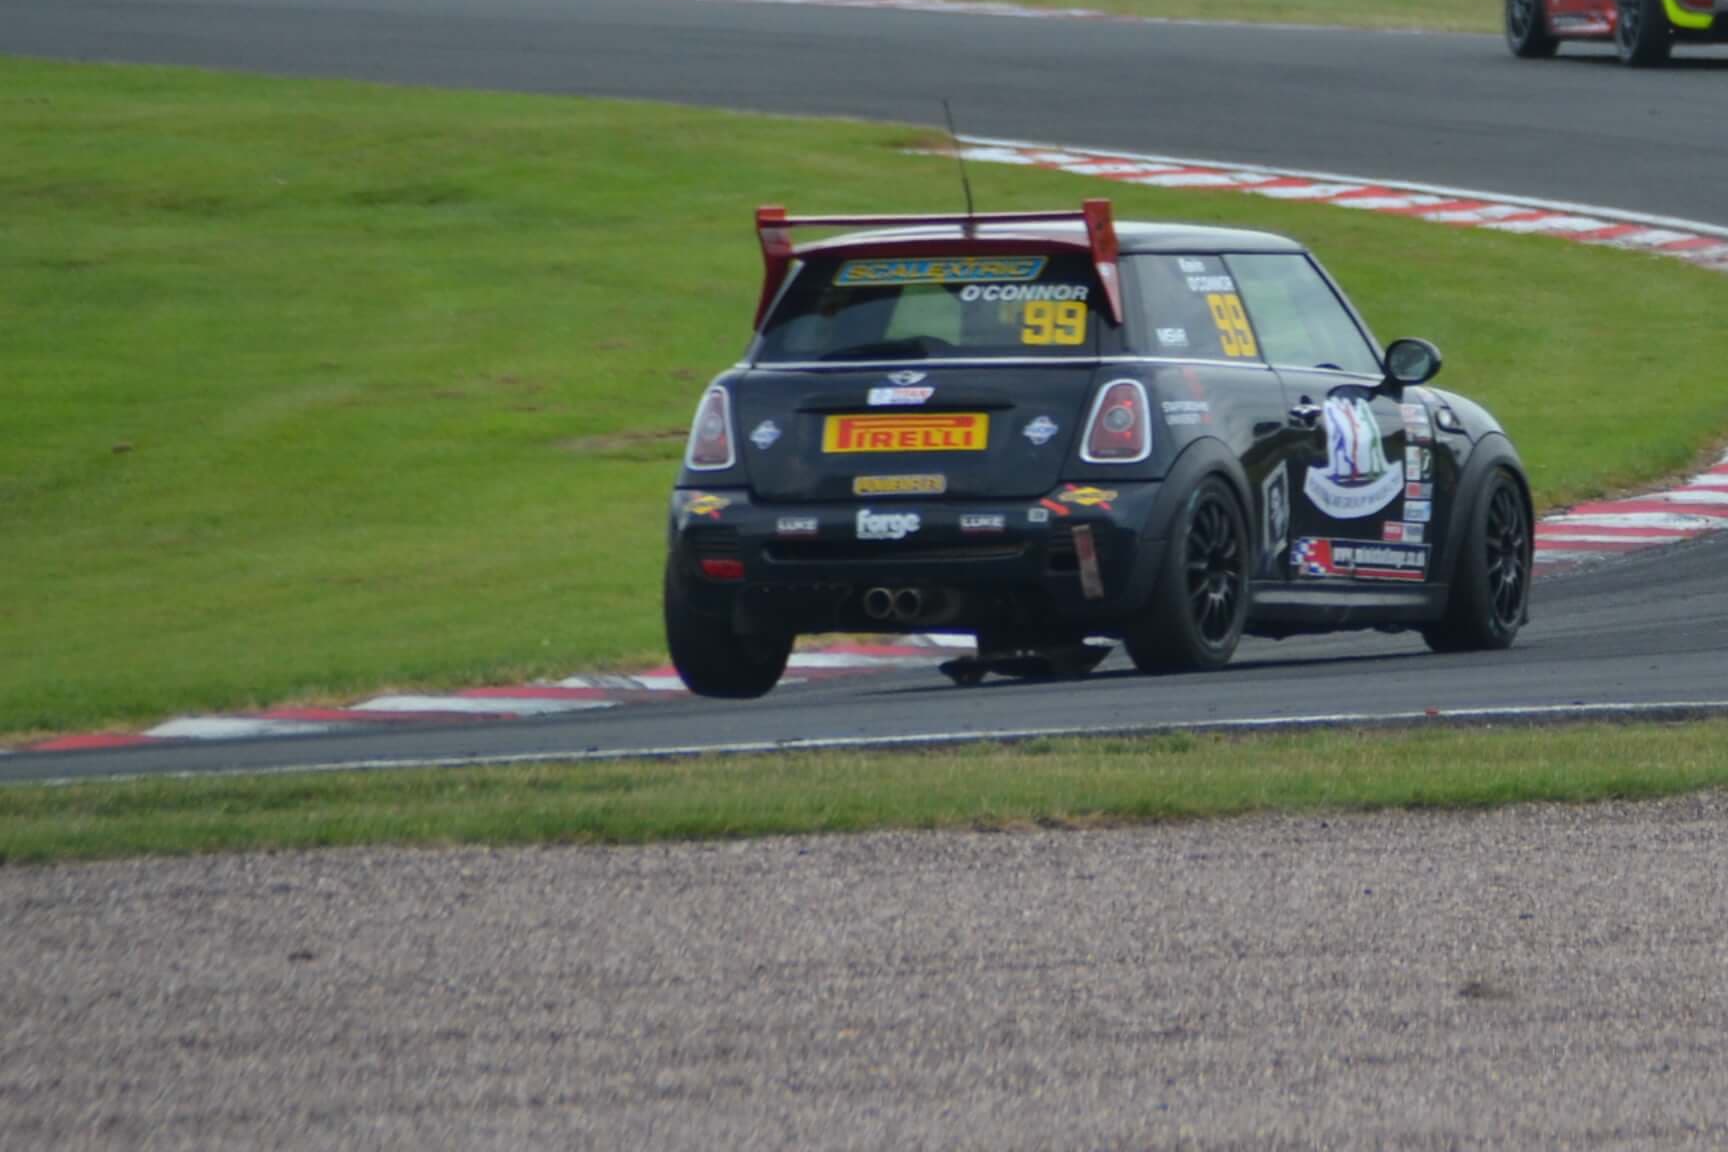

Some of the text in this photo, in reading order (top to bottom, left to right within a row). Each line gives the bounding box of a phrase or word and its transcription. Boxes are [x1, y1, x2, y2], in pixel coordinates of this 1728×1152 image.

[960, 284, 1089, 302] O'CONNOR
[1021, 301, 1088, 346] 99
[1206, 292, 1258, 357] 99
[836, 415, 977, 449] PIRELLI
